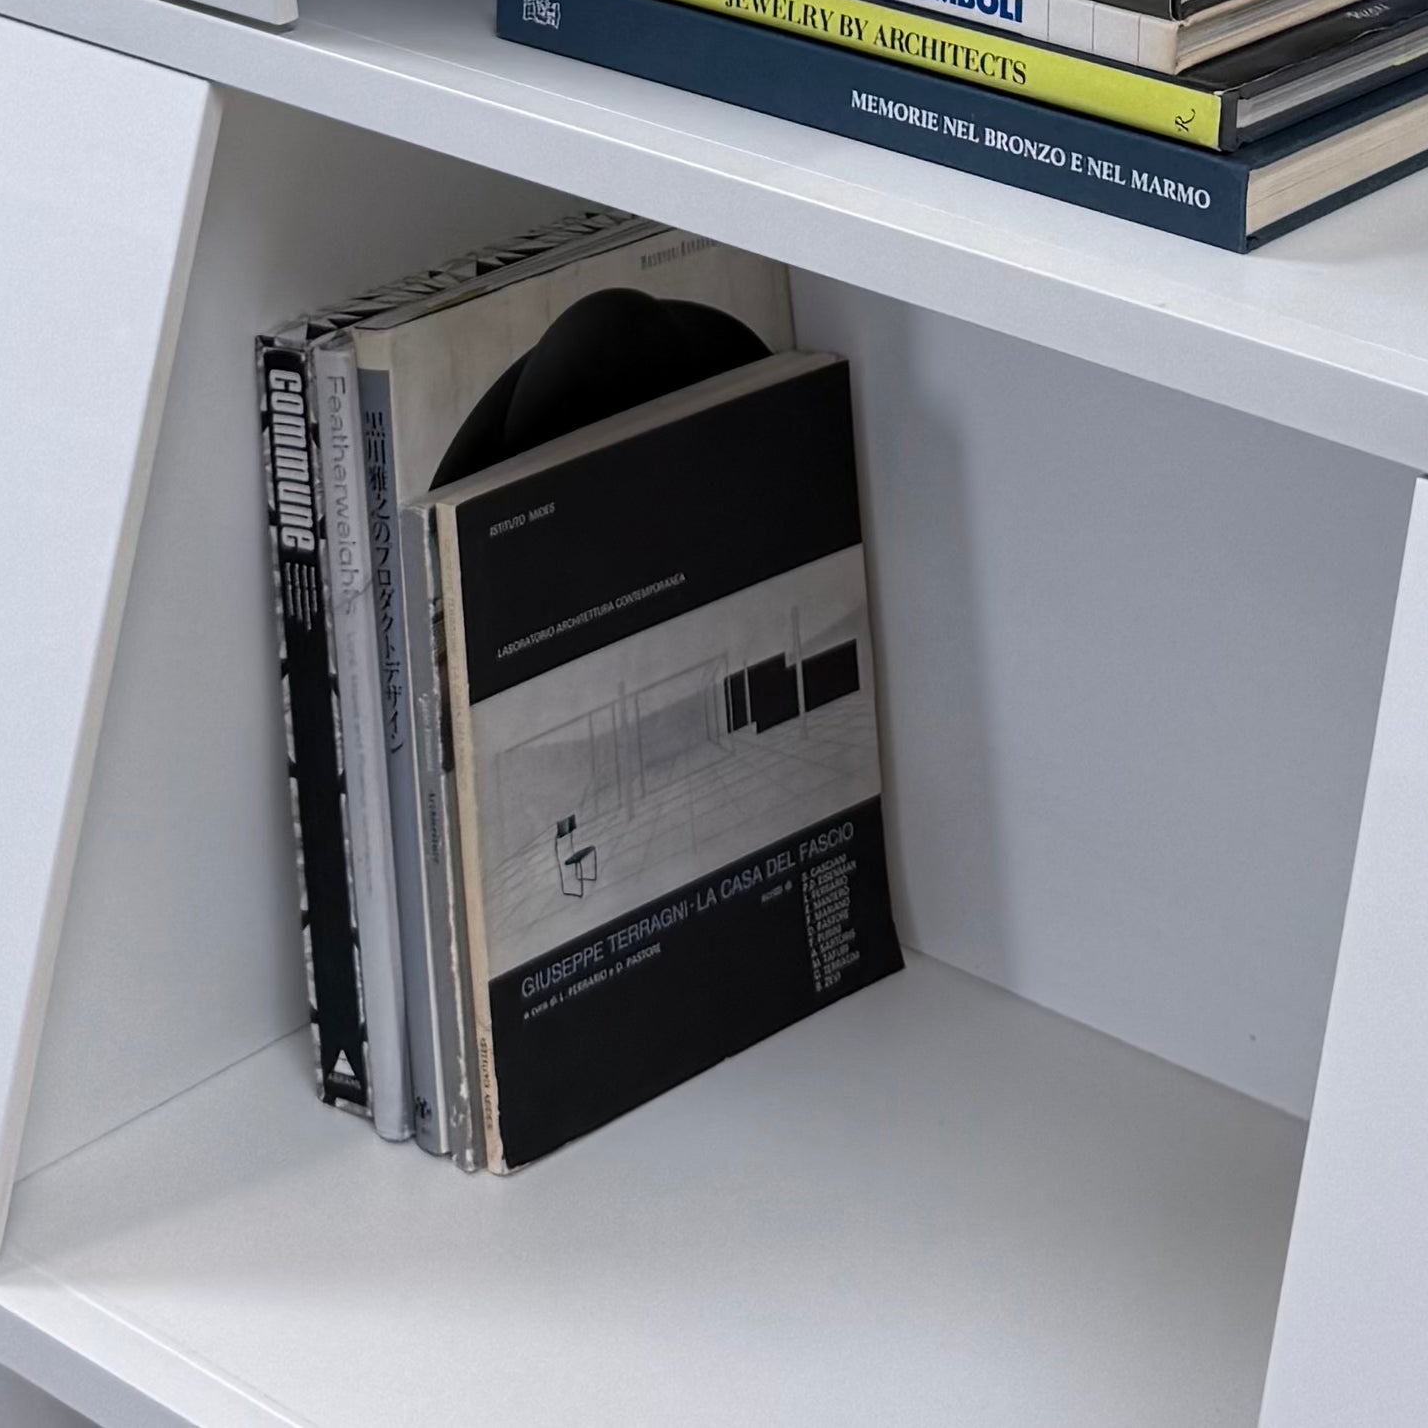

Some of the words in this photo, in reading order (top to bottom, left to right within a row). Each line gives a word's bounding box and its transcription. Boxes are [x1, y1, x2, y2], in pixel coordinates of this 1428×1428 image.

[839, 13, 869, 41] BY
[873, 24, 1028, 86] ARCHITECTS
[850, 89, 940, 133] MEMORIE
[943, 114, 980, 144] NEL
[983, 127, 1067, 168] BRONZO
[1070, 151, 1083, 173] E
[1086, 156, 1126, 186] NEL
[1130, 169, 1212, 210] MARMO
[268, 368, 316, 552] commune
[489, 513, 527, 538] ISTITUTO
[497, 625, 556, 659] LABORATORIO
[556, 600, 615, 635] ARCHITETTURA
[614, 572, 686, 609] CONTEMPORANEA
[521, 940, 604, 999] GIUSEPPE
[606, 902, 690, 956] TERRAGNI
[696, 887, 718, 913] LA
[720, 865, 764, 899] CASA
[766, 849, 797, 879] DEL
[798, 821, 855, 863] FASCIO
[626, 942, 662, 969] PASTORE
